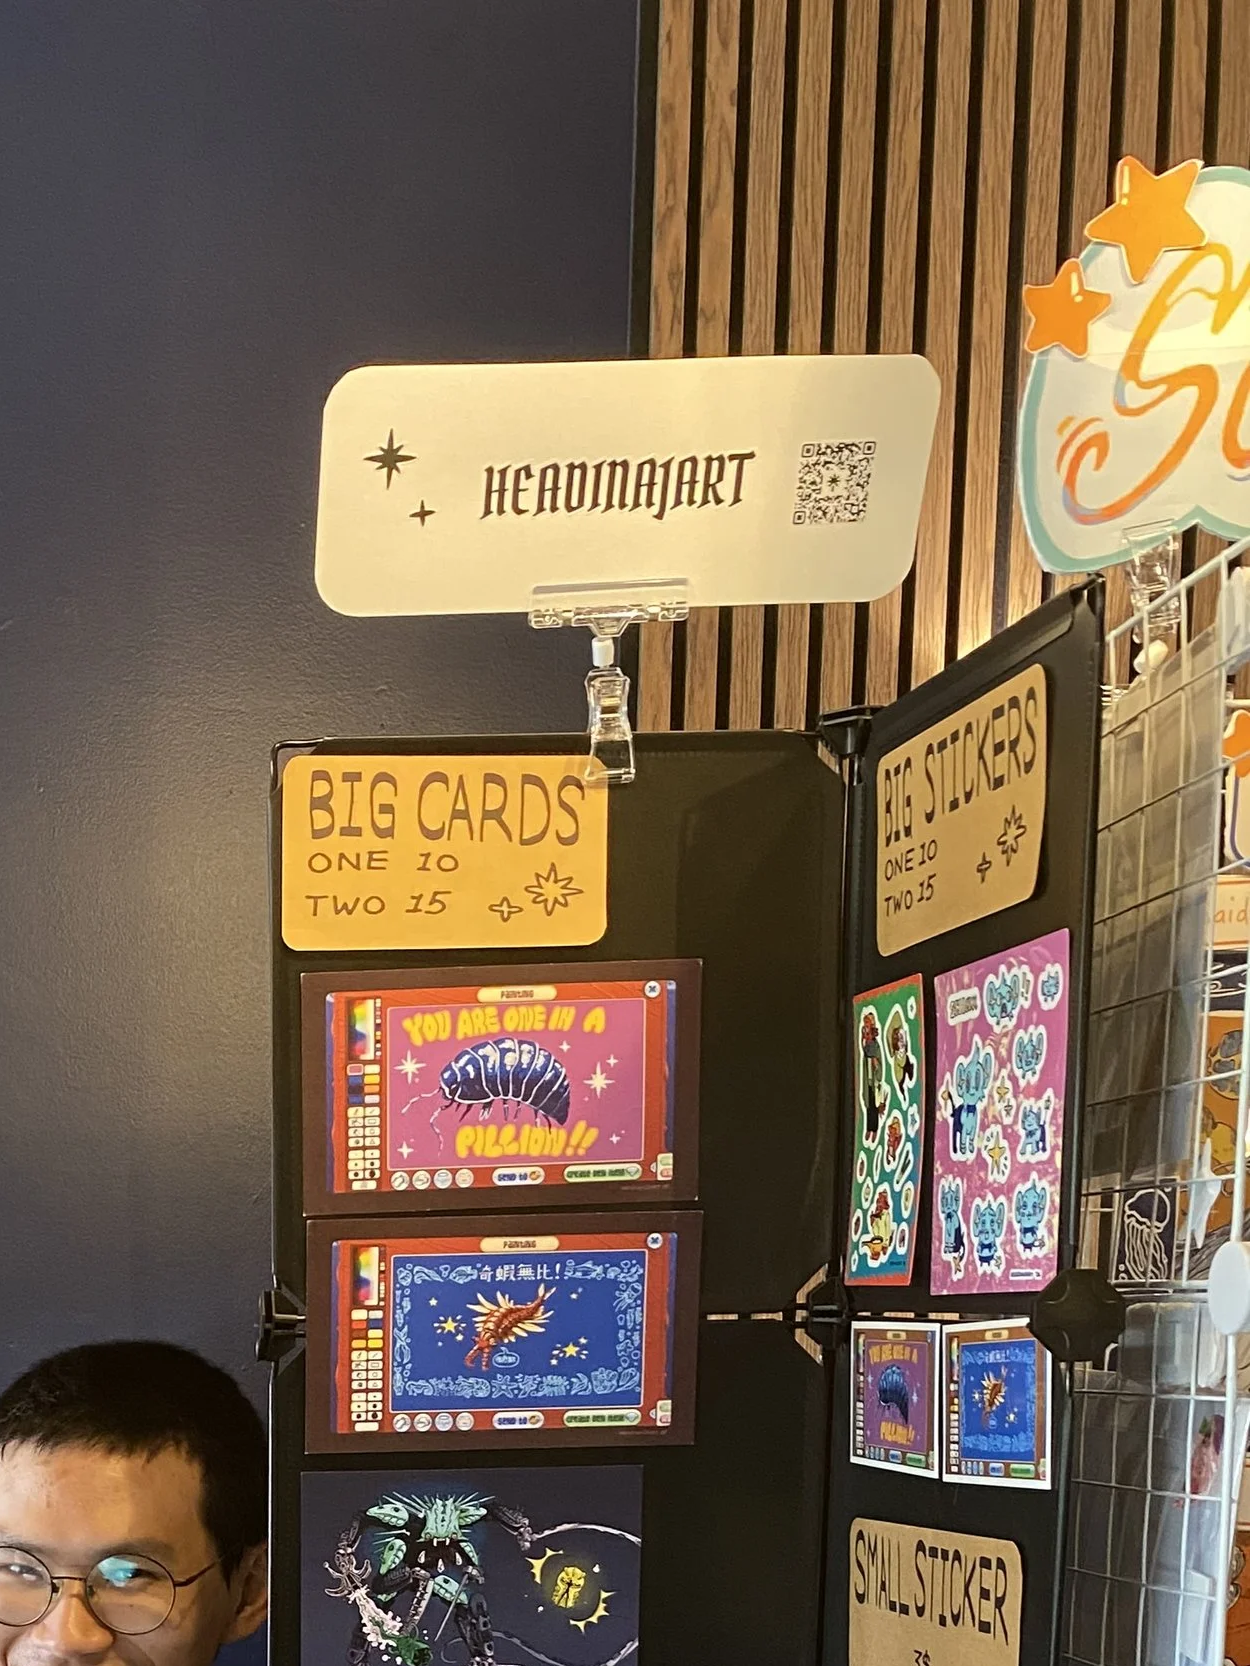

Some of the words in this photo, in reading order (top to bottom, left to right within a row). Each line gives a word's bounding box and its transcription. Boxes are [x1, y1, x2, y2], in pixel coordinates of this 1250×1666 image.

[480, 450, 756, 520] HEADINAJART
[883, 755, 914, 849] BIG
[923, 685, 1038, 825] STICKERS
[308, 768, 397, 841] BIG
[417, 771, 587, 847] CARDS
[307, 851, 389, 874] ONE
[416, 852, 459, 873] 10
[884, 850, 915, 882] ONE
[917, 838, 938, 866] 10
[305, 894, 386, 917] TWO
[405, 890, 453, 916] 15
[884, 887, 913, 918] TWO
[917, 875, 936, 903] 15
[402, 1009, 452, 1047] YOU
[456, 1006, 500, 1041] ARE
[503, 1004, 547, 1033] ONE
[548, 1006, 576, 1031] IN
[582, 1006, 606, 1034] A
[455, 1119, 599, 1159] PILLION!!
[854, 1529, 910, 1618] SMALL
[914, 1539, 1009, 1647] STICKER
